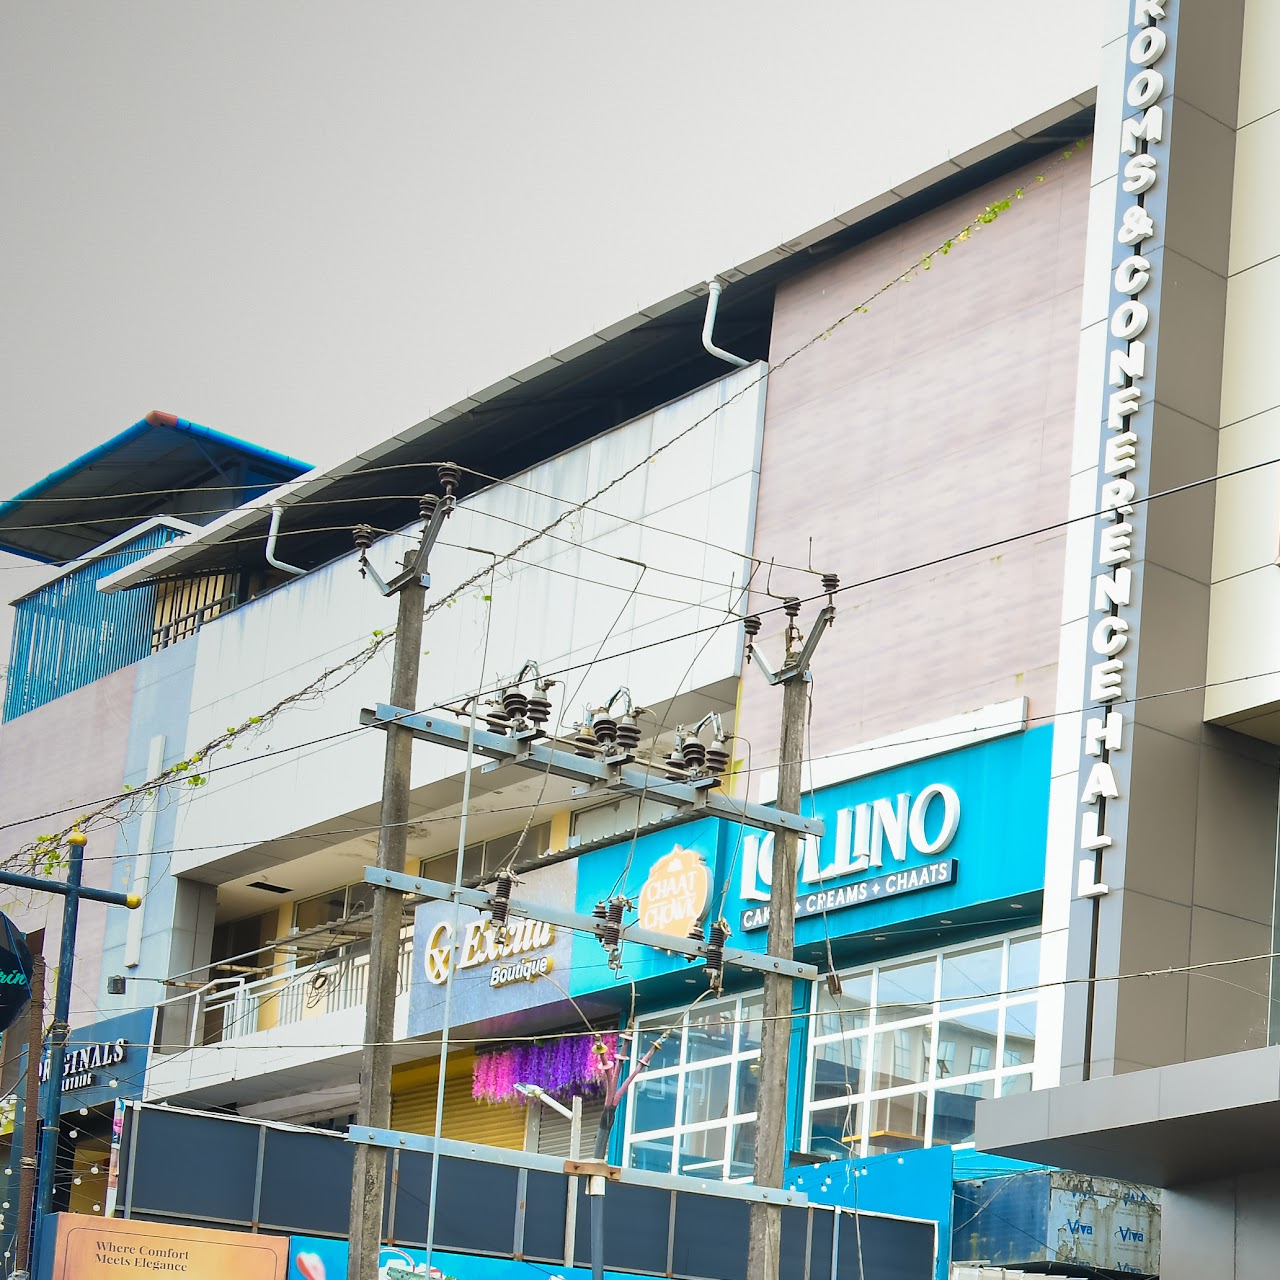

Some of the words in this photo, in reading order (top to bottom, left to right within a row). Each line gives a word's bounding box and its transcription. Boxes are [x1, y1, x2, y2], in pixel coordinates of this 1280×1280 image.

[1118, 206, 1153, 246] &
[1090, 255, 1151, 703] CONFERENCE
[1078, 711, 1123, 898] HALL
[743, 911, 771, 928] CAK
[806, 883, 867, 912] CREAMS
[885, 863, 948, 892] CHAATS
[490, 956, 548, 987] Boutique
[96, 1241, 136, 1255] Where
[139, 1245, 189, 1260] Comfort
[1119, 1226, 1143, 1242] Viva
[95, 1253, 131, 1267] Meets
[134, 1258, 188, 1272] Elegance
